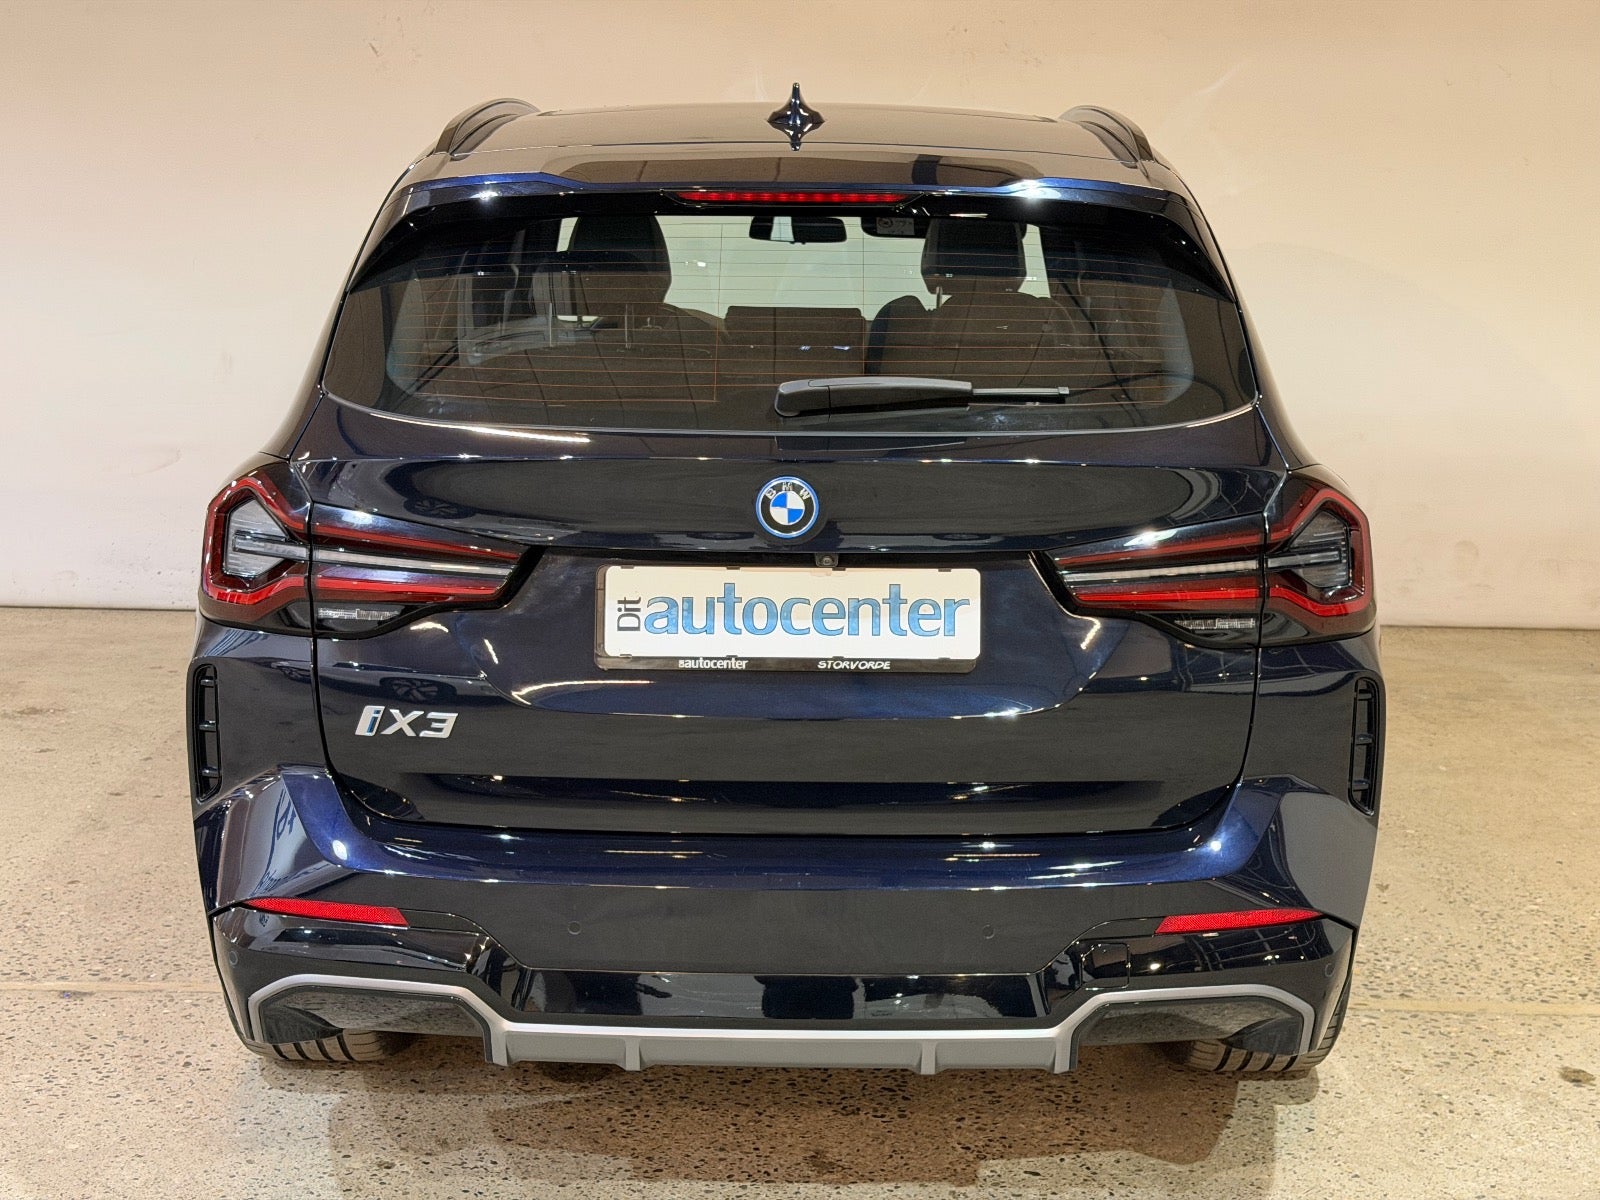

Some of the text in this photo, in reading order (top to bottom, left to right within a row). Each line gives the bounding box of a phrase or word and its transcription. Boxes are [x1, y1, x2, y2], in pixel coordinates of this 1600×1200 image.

[765, 481, 811, 500] BMW
[617, 583, 970, 637] Dit autocenter
[684, 657, 749, 669] autocenter
[817, 660, 891, 670] STORVORDE
[355, 705, 459, 739] iX3
